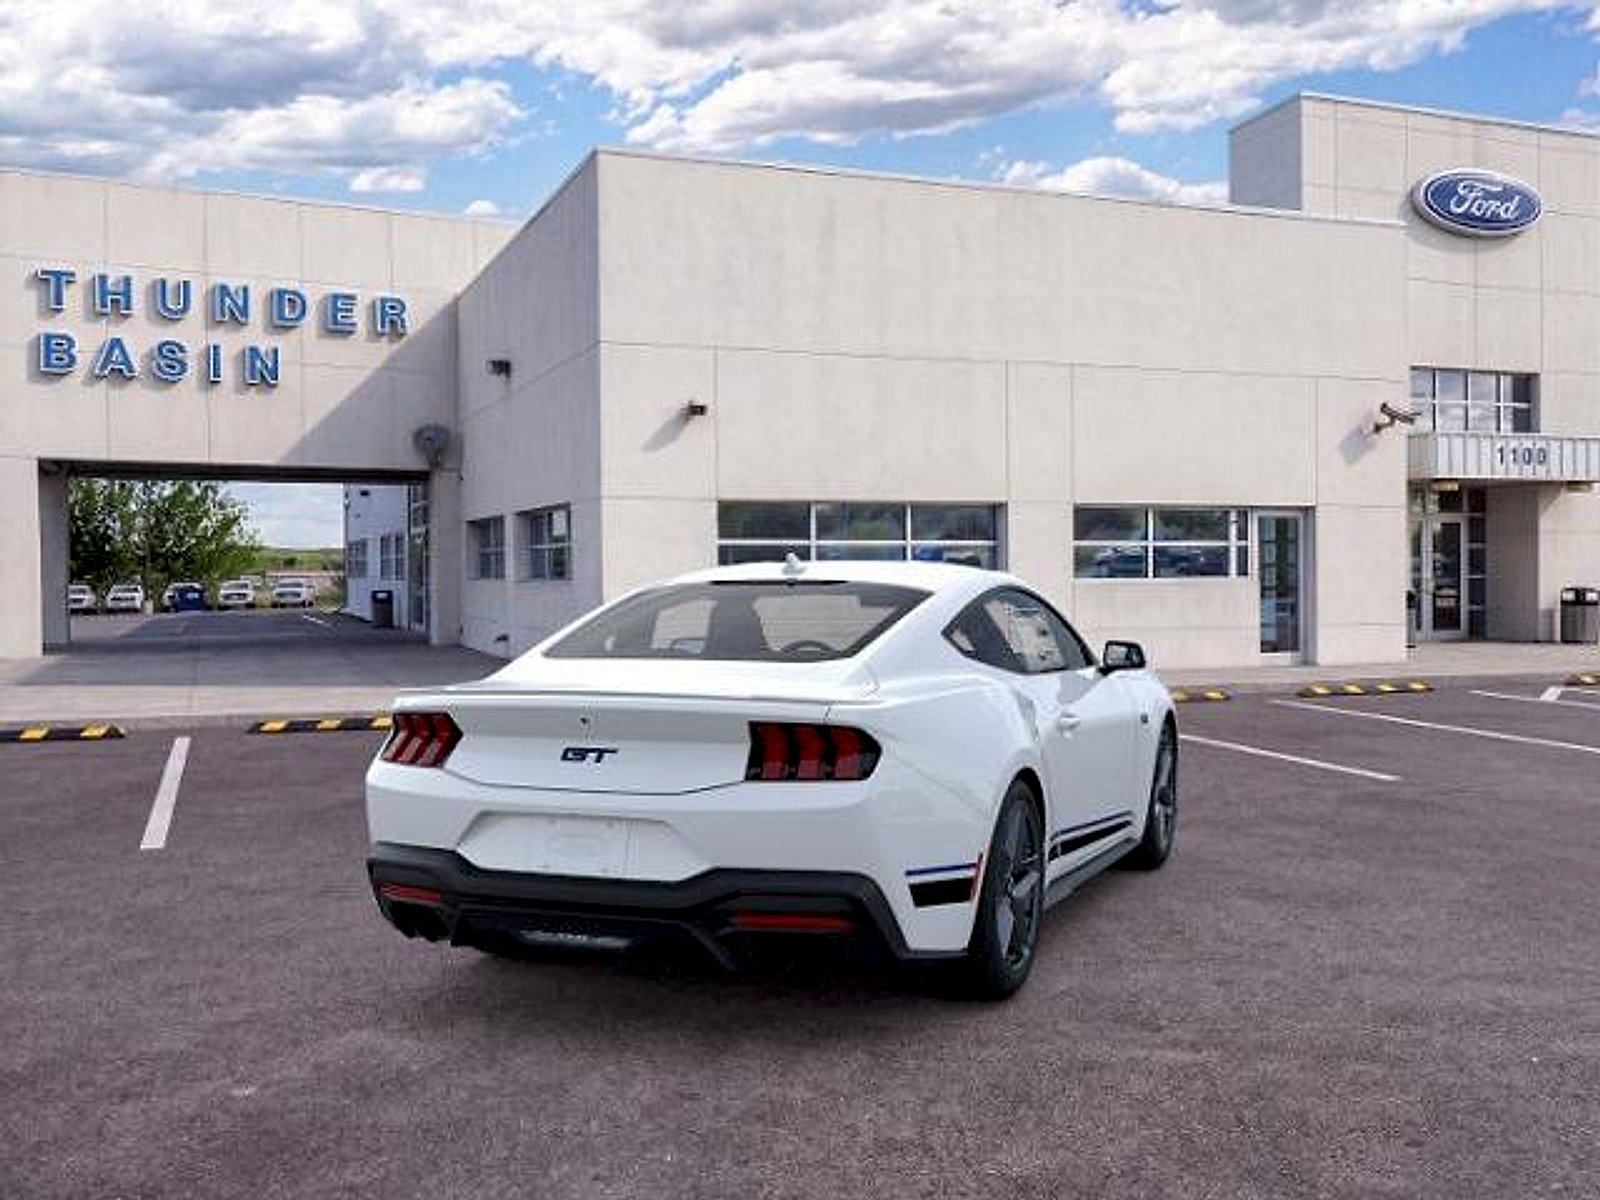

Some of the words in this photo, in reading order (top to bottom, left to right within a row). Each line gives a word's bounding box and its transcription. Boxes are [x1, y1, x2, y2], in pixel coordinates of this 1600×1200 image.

[1450, 180, 1519, 219] Ford
[38, 268, 410, 335] THUNDER
[38, 331, 282, 386] BASIN
[1497, 446, 1546, 466] 1100
[560, 747, 618, 763] GT
